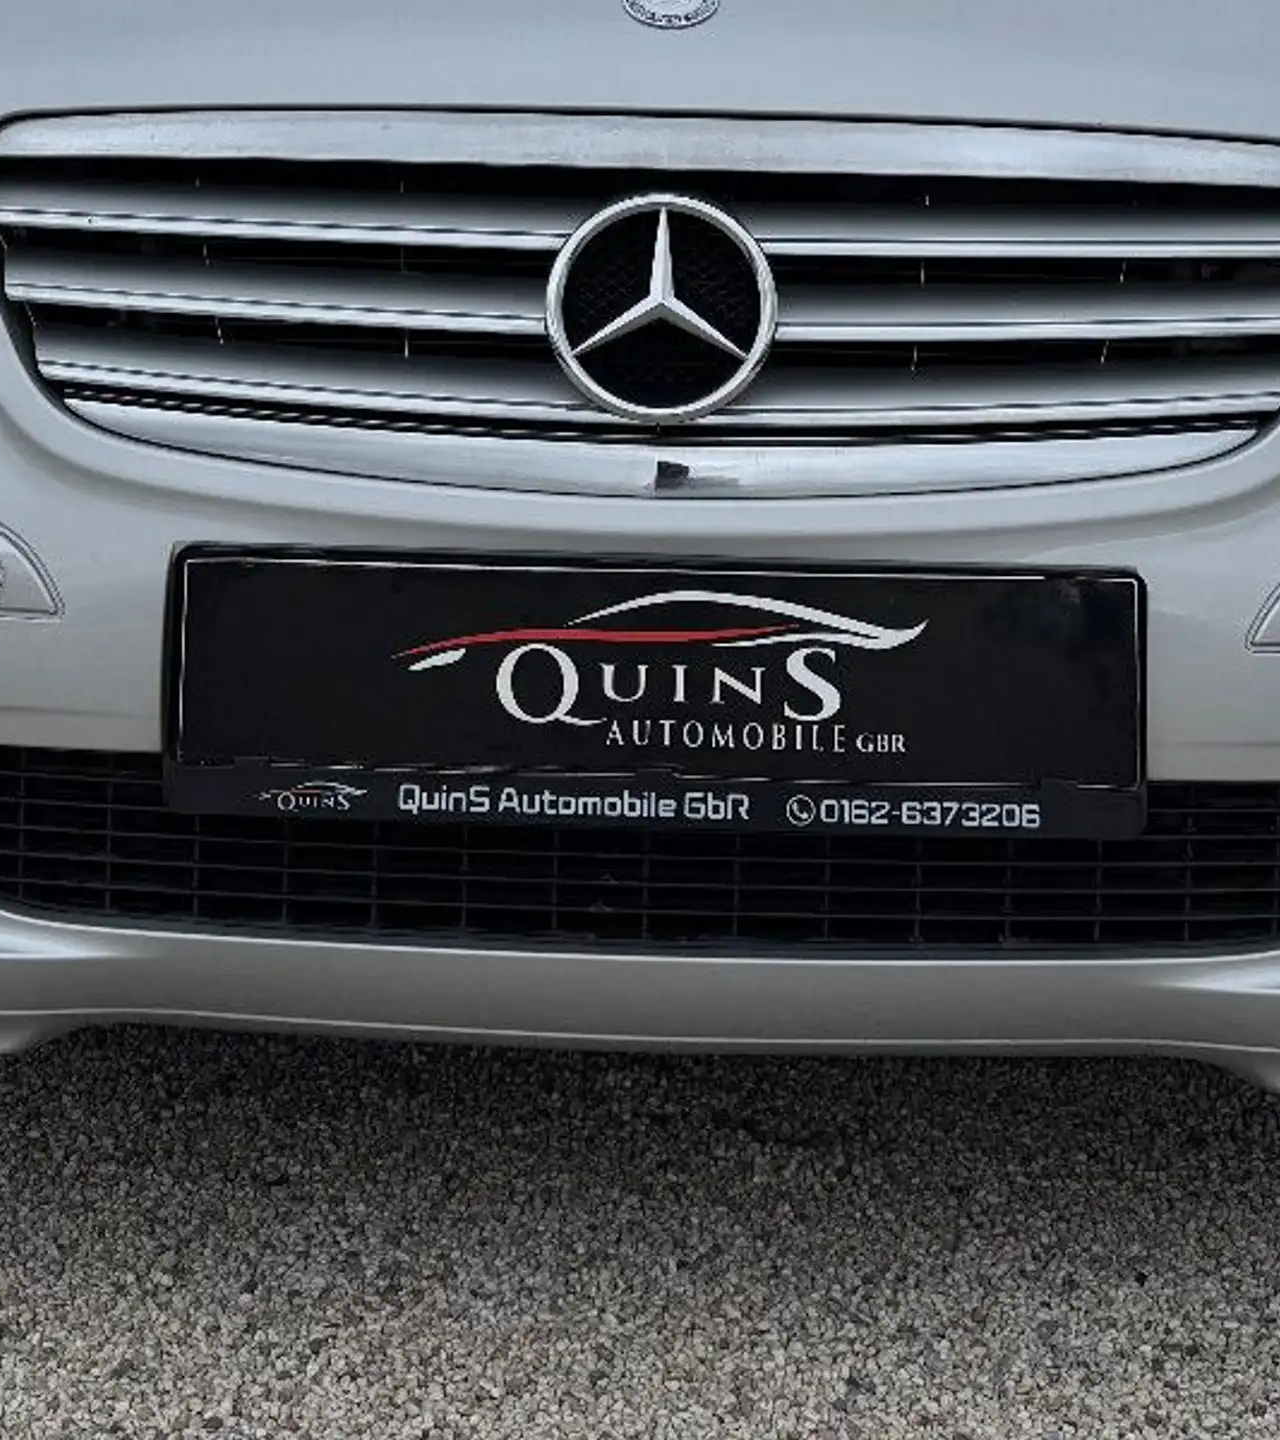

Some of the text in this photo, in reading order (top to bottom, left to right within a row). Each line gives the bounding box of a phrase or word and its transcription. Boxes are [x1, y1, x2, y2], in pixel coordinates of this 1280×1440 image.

[605, 719, 907, 754] AUTOMOBILE GBR
[397, 783, 1041, 828] QuinS Automobile GbR 0162-6373206
